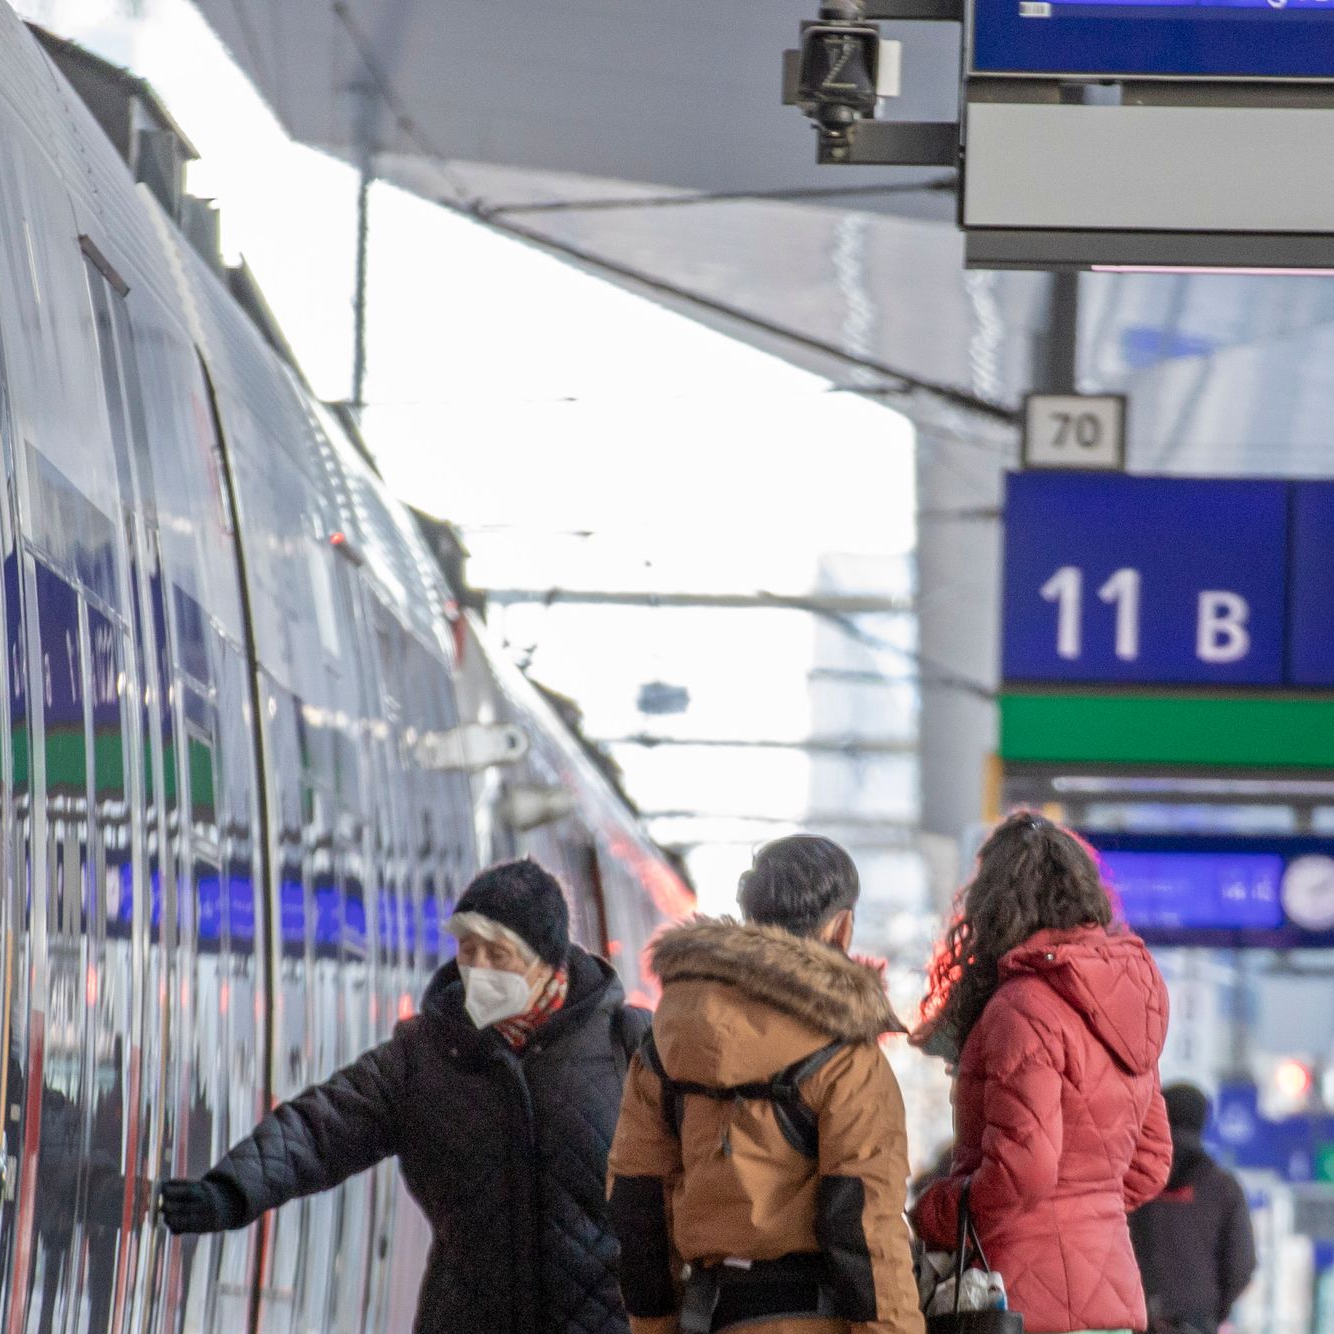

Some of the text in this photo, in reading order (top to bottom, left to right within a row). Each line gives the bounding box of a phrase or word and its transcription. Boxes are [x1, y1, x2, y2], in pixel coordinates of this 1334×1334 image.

[1049, 411, 1103, 449] 70
[1039, 565, 1250, 664] 11 B
